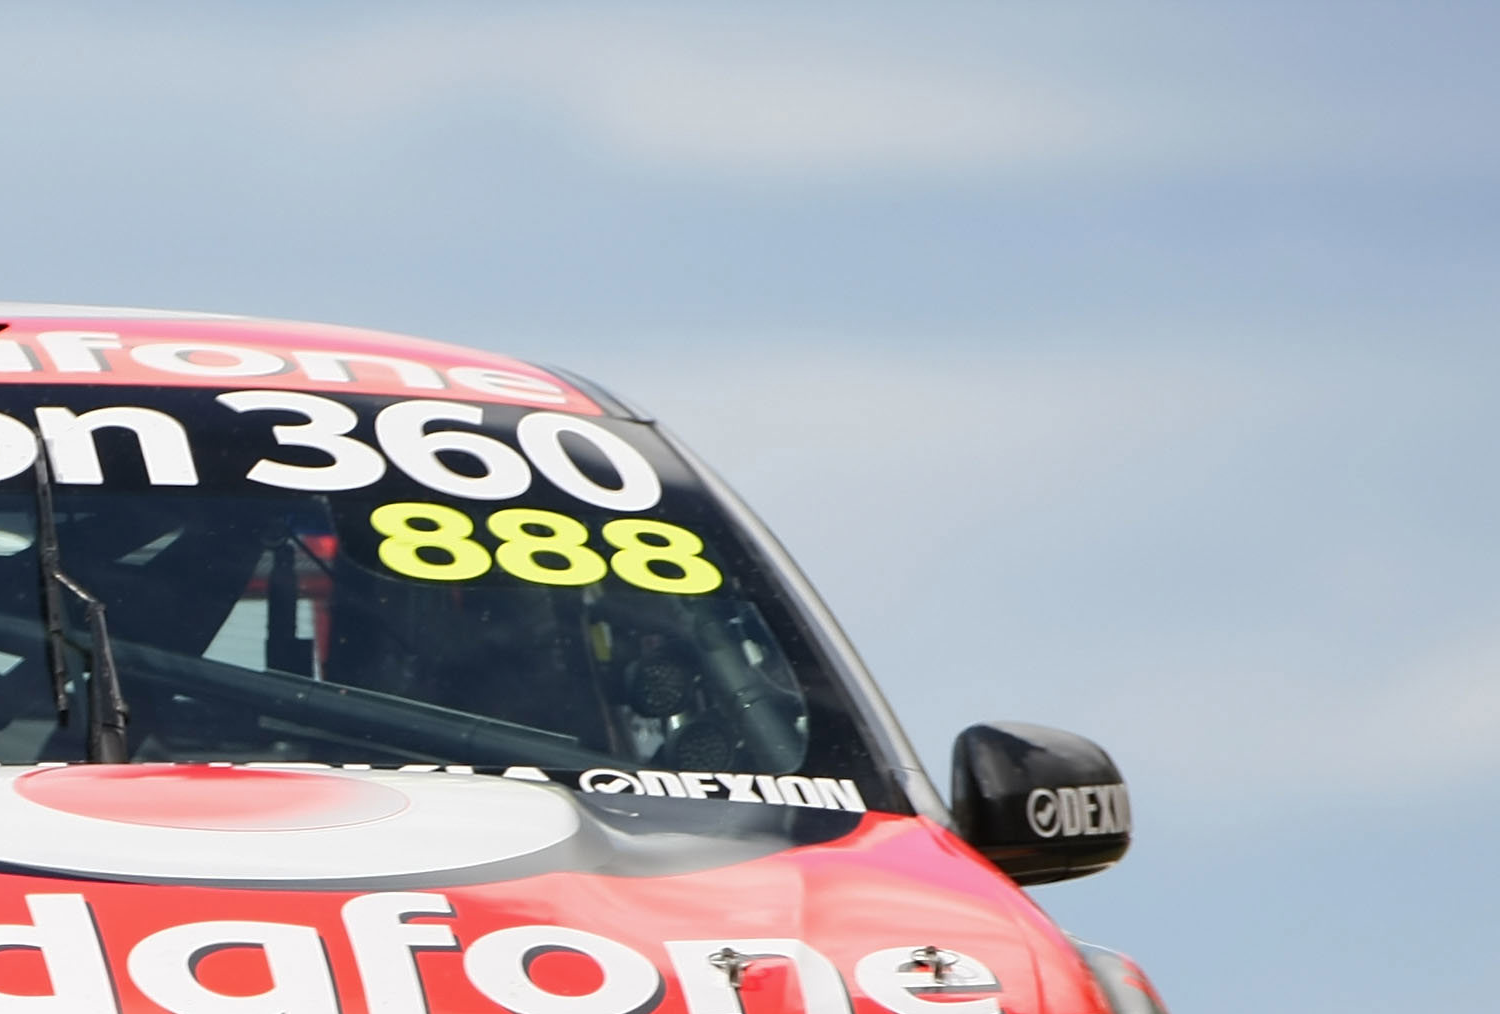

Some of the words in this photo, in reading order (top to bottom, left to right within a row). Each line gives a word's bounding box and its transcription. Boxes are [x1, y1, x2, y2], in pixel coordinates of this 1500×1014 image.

[215, 390, 661, 512] 360
[370, 502, 723, 594] 888
[636, 769, 867, 812] DEXION
